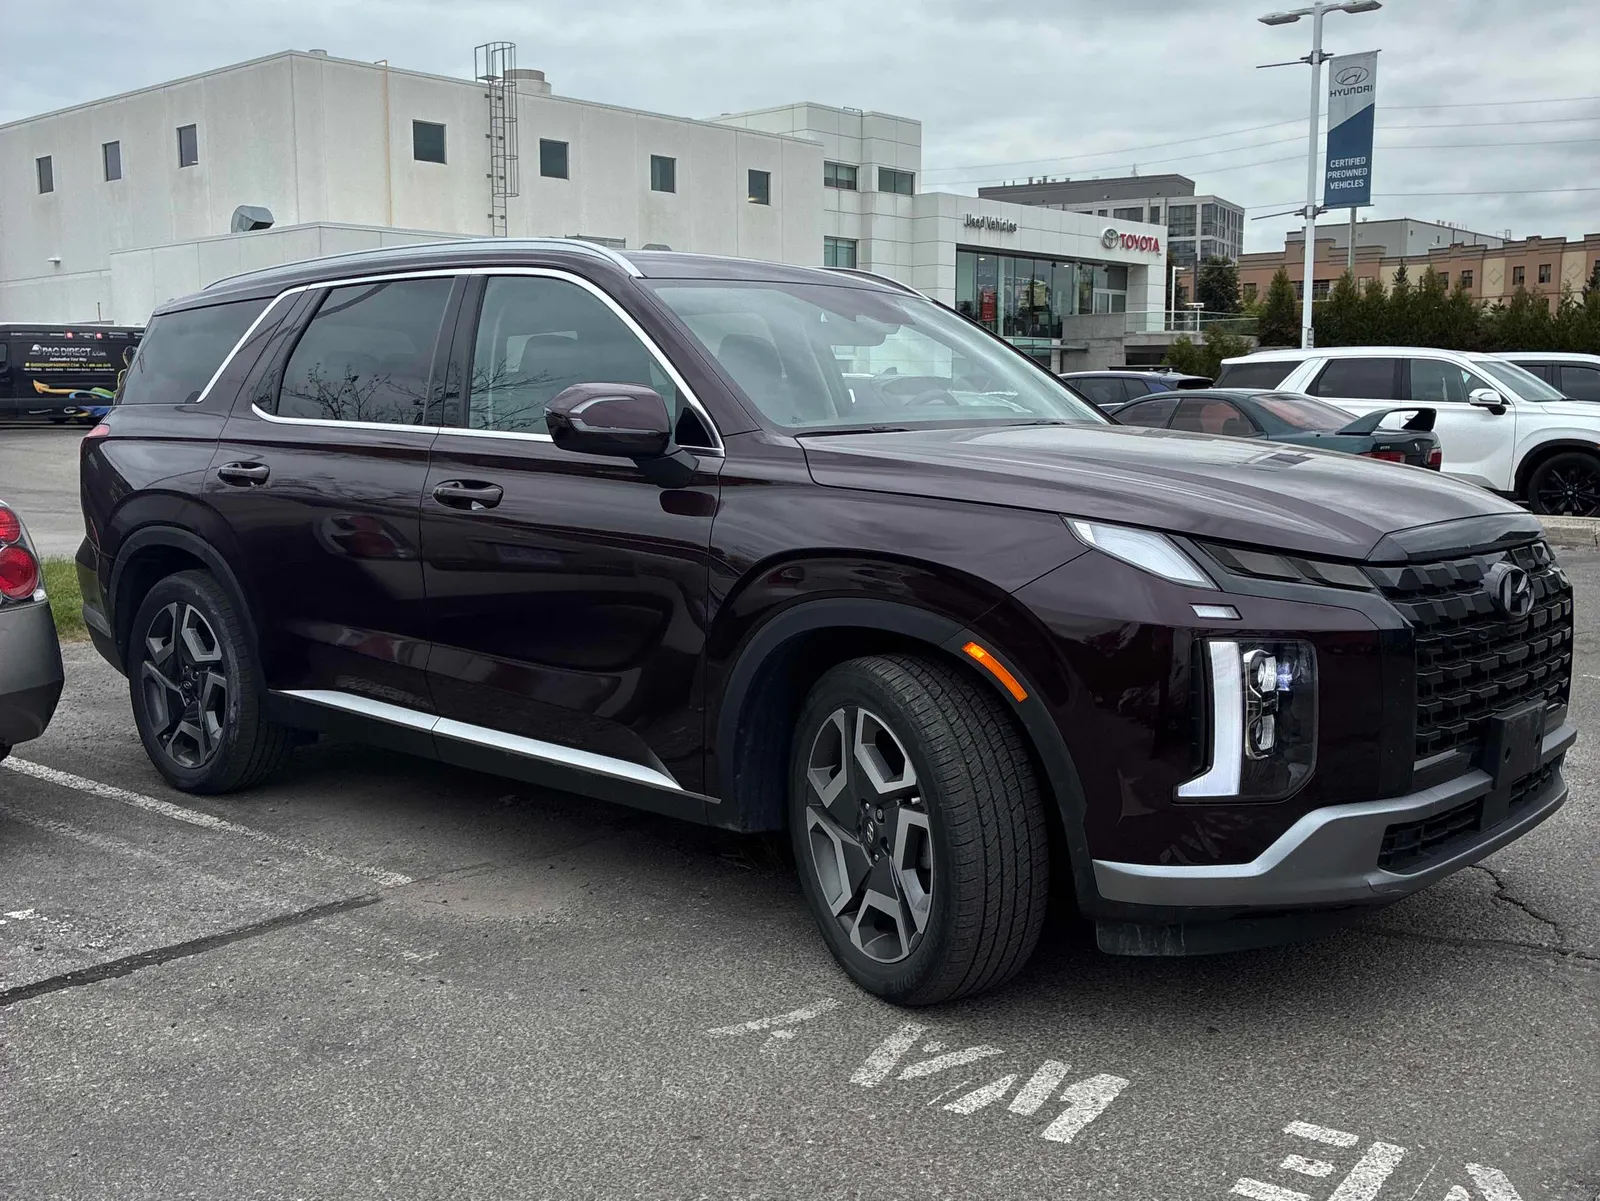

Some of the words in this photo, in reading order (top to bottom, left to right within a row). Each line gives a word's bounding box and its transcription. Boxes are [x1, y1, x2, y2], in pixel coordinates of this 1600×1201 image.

[1329, 84, 1373, 97] HYUNDAI
[1330, 156, 1366, 168] CERTIFIED
[1327, 167, 1368, 179] PREOWNED
[1330, 178, 1364, 190] VEHICLES
[963, 213, 985, 229] Used
[985, 215, 1017, 233] Vehicles
[1119, 233, 1160, 252] TOYOTA
